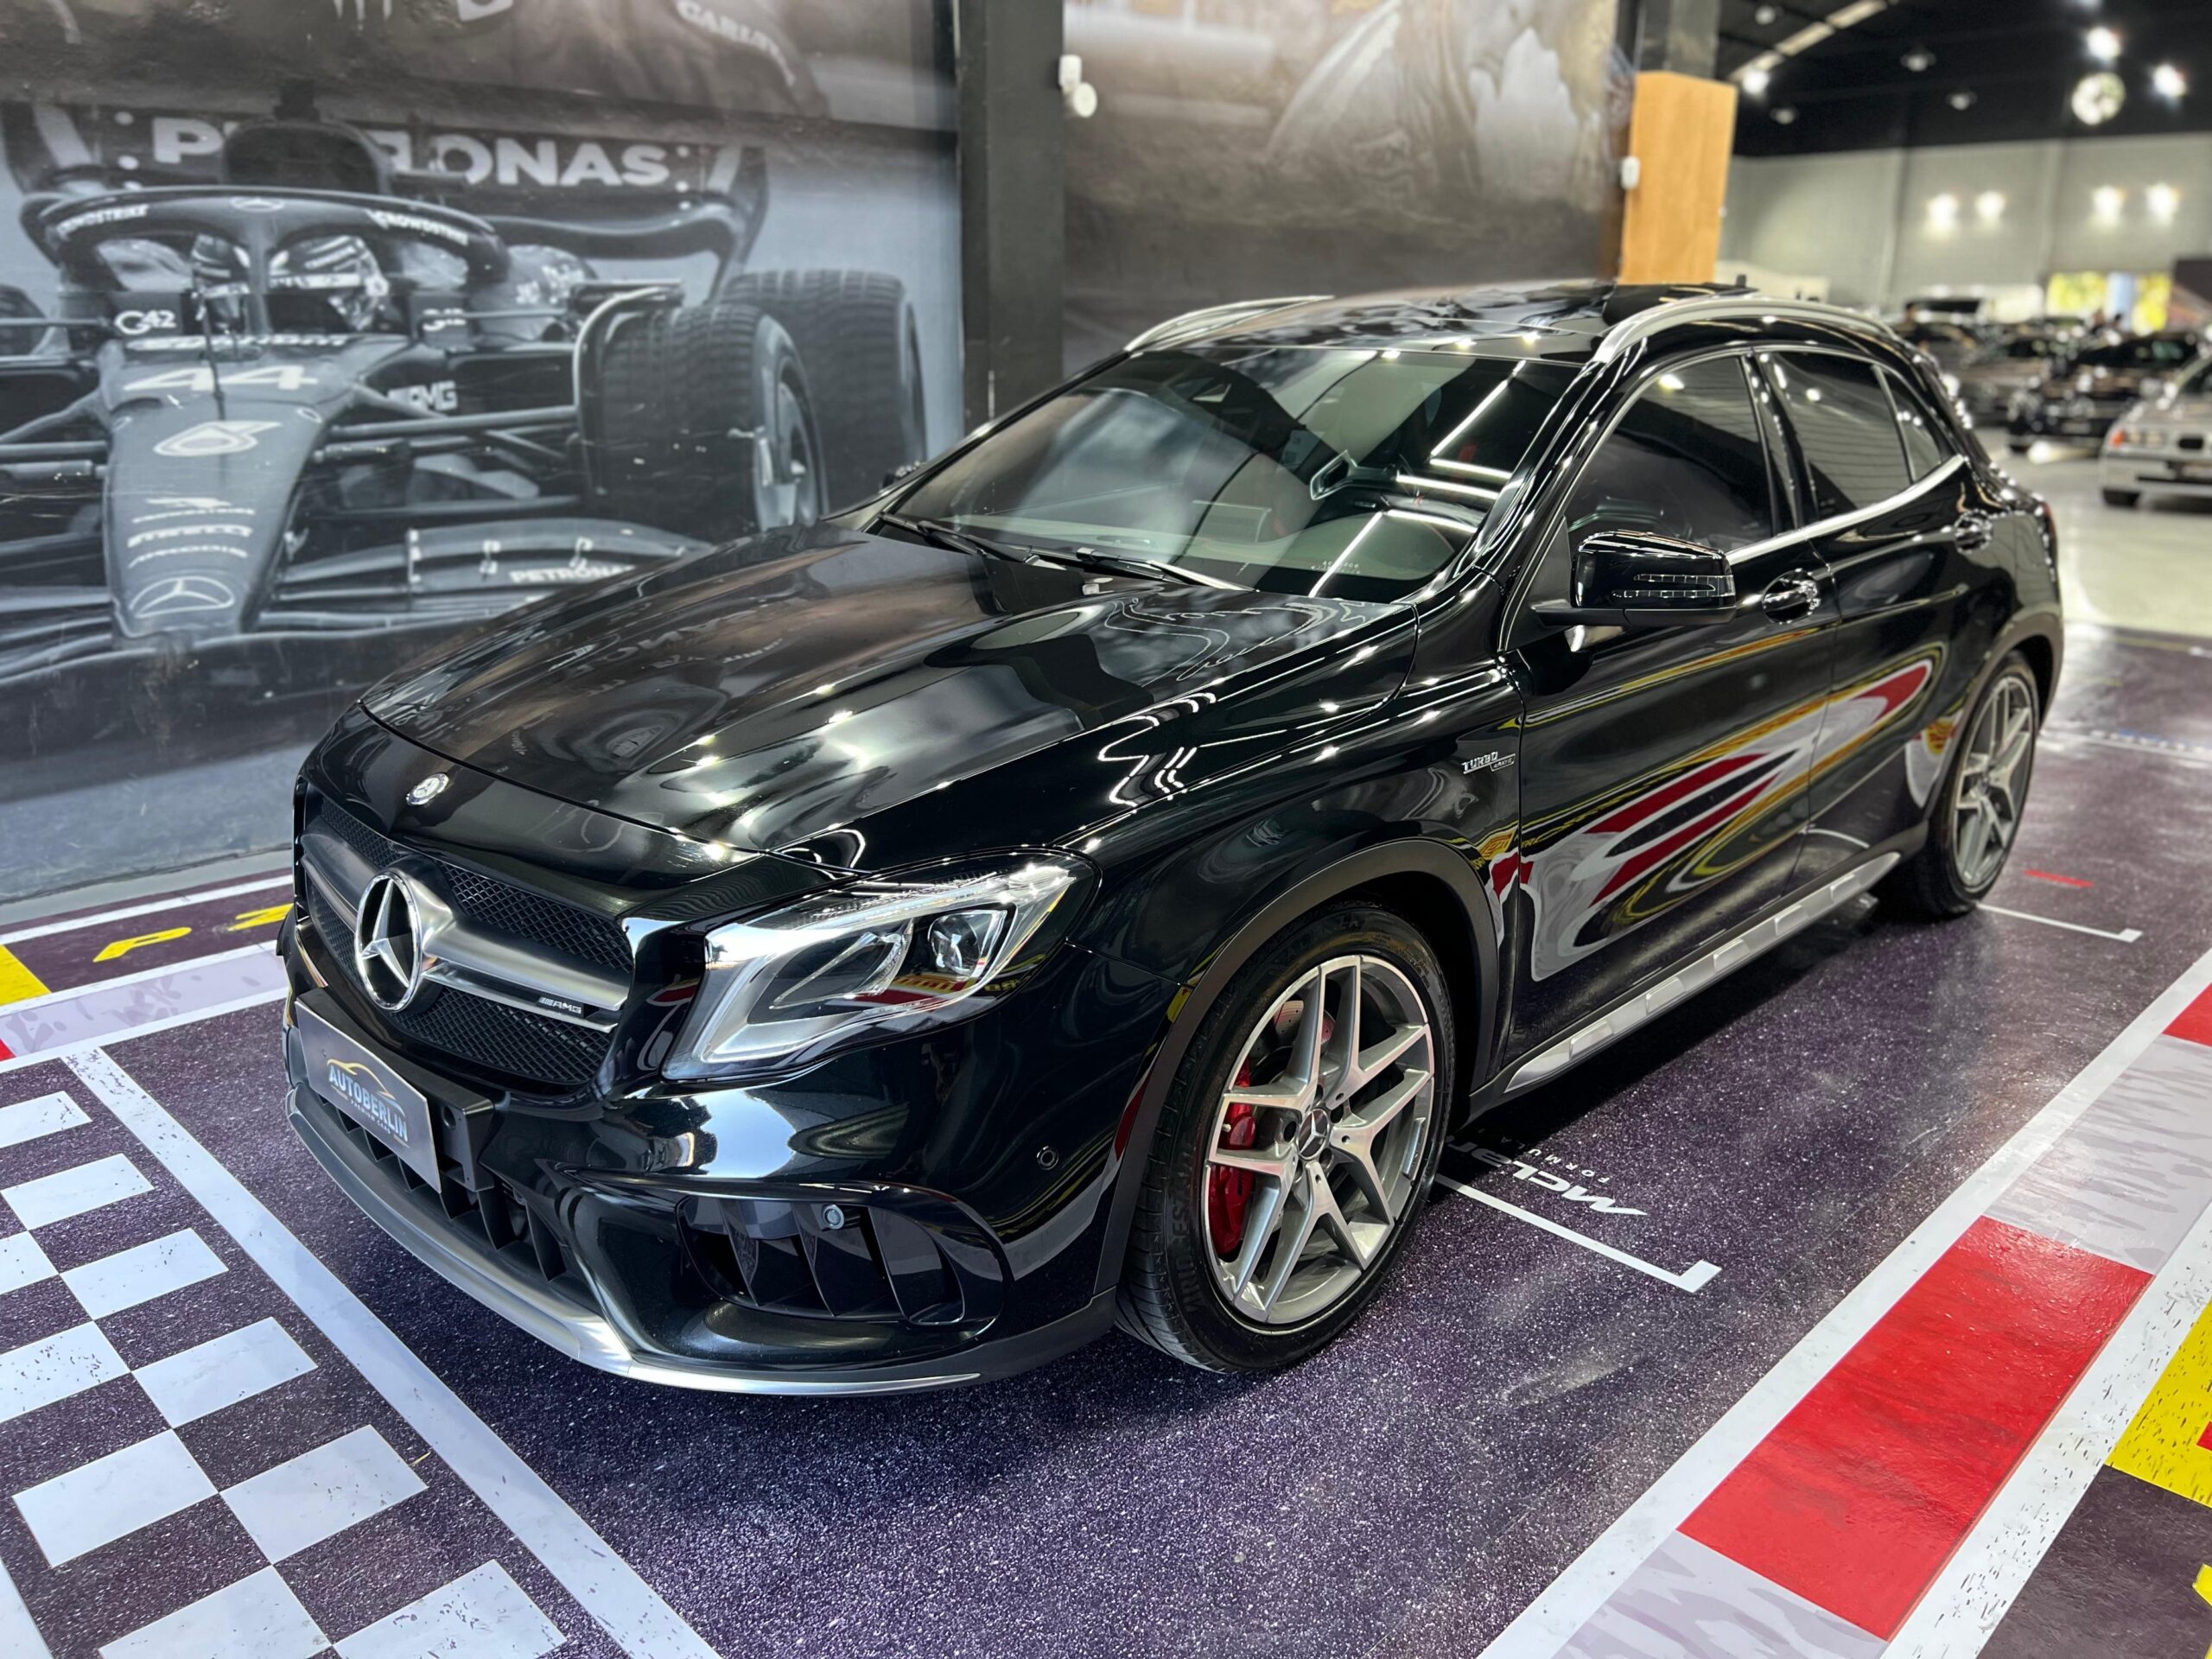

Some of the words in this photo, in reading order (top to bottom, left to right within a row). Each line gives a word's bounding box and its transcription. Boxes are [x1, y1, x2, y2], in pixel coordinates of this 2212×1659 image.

[124, 365, 318, 391] 44
[1461, 751, 1498, 772] TURBO
[553, 1001, 582, 1014] AMG
[329, 1065, 409, 1142] AUTOBERLIN
[1446, 1135, 1648, 1216] McLar
